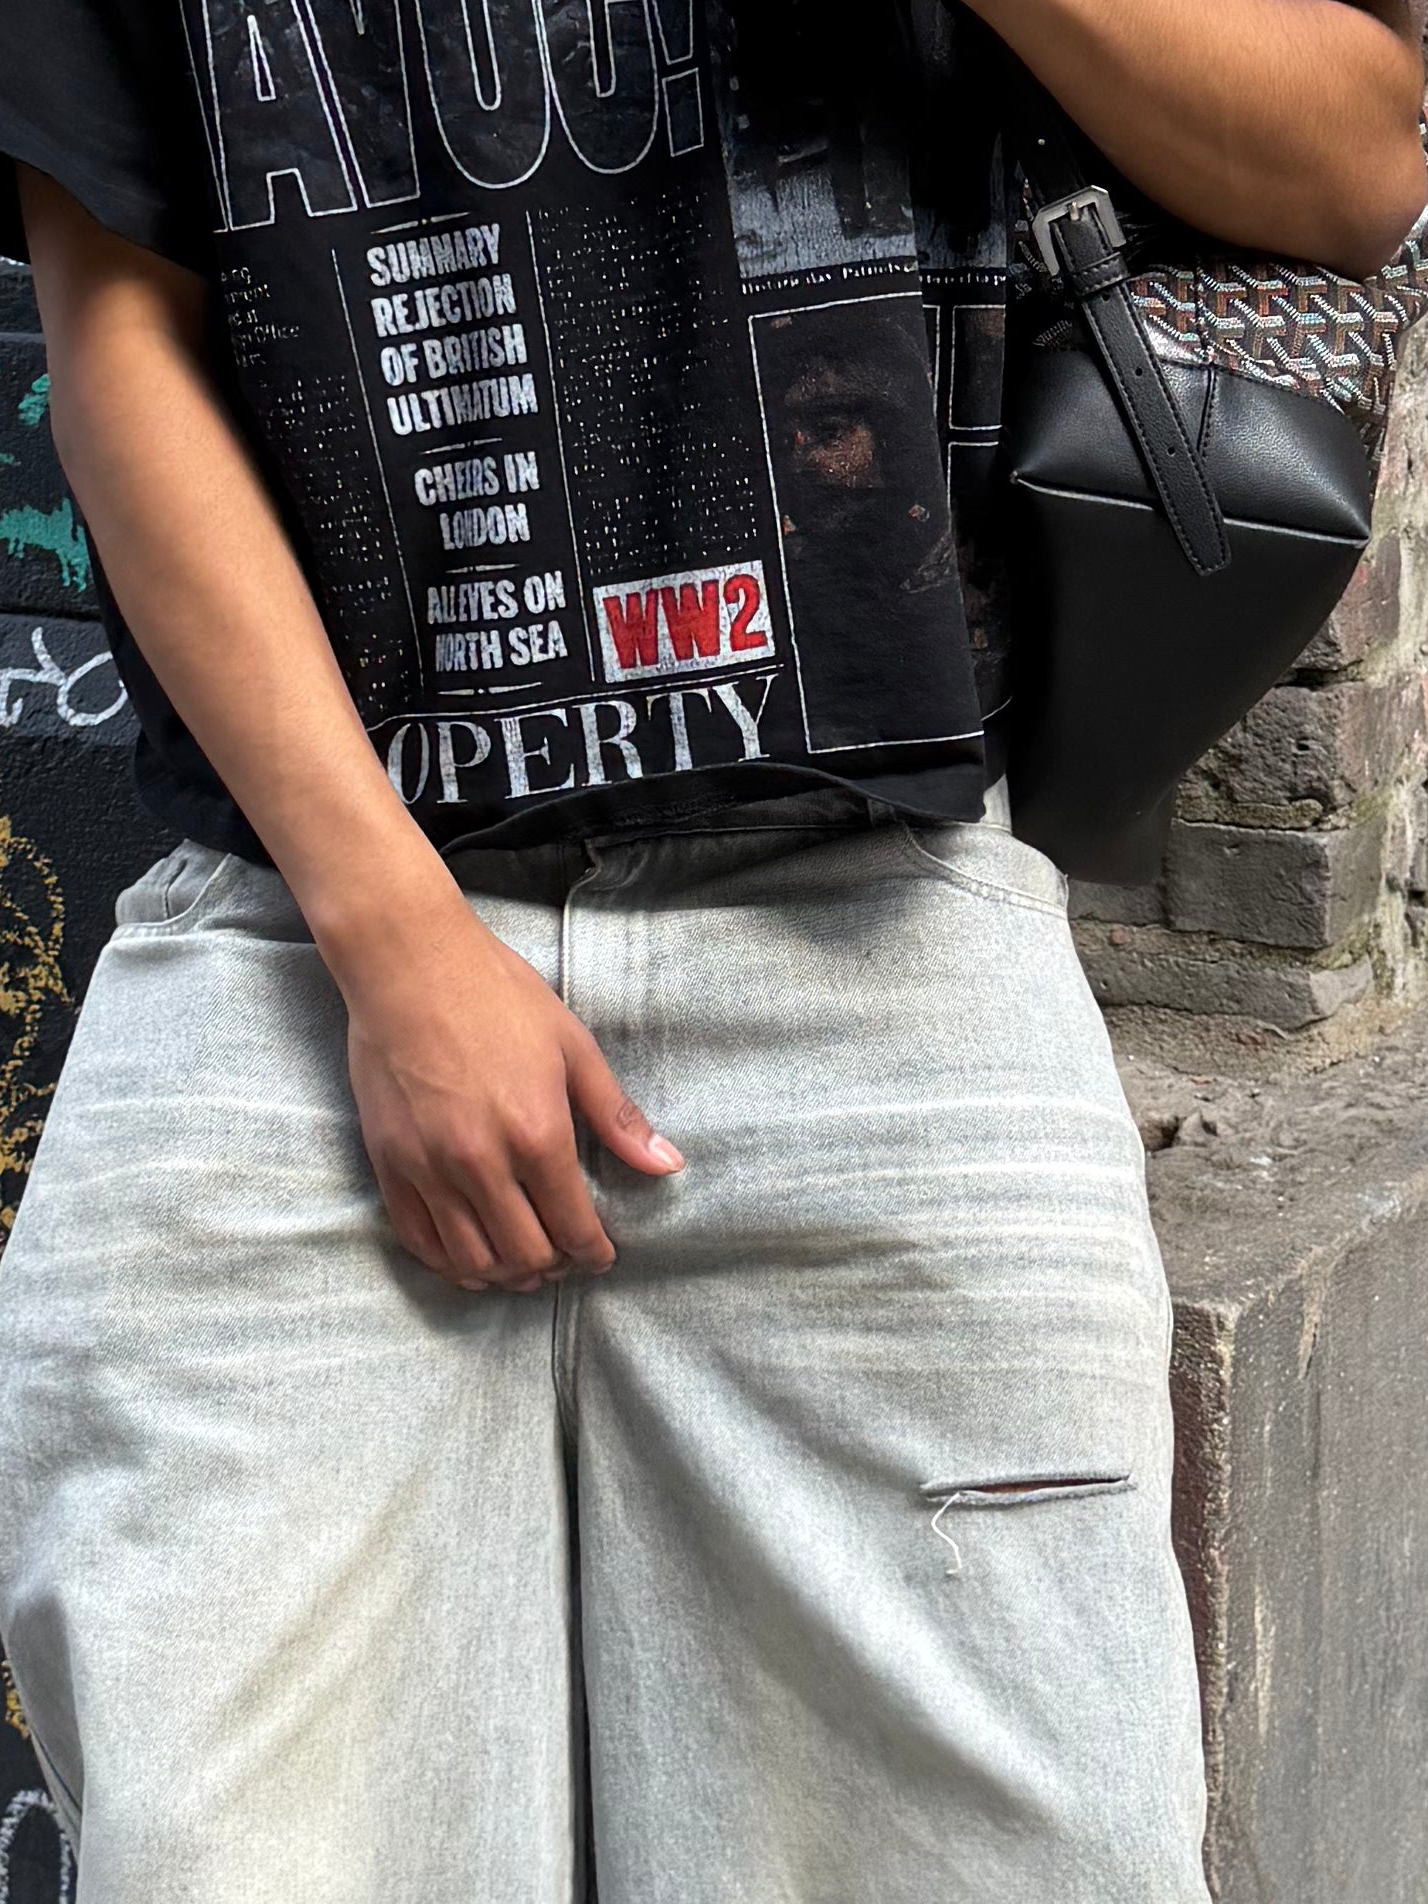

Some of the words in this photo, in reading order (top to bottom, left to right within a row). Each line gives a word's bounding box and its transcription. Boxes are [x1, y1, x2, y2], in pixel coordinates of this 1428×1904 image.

[366, 222, 501, 287] SUMMARY
[370, 273, 517, 338] REJECTION
[380, 343, 419, 386] OF
[421, 323, 528, 379] BRITISH
[386, 373, 539, 436] ULTIMATUM
[503, 451, 541, 494] IN
[439, 503, 531, 551] LONDON
[458, 579, 520, 623] EYES
[522, 569, 567, 614] ON
[601, 573, 769, 670] WW2
[435, 629, 504, 673] NORTH
[507, 619, 569, 667] SEA
